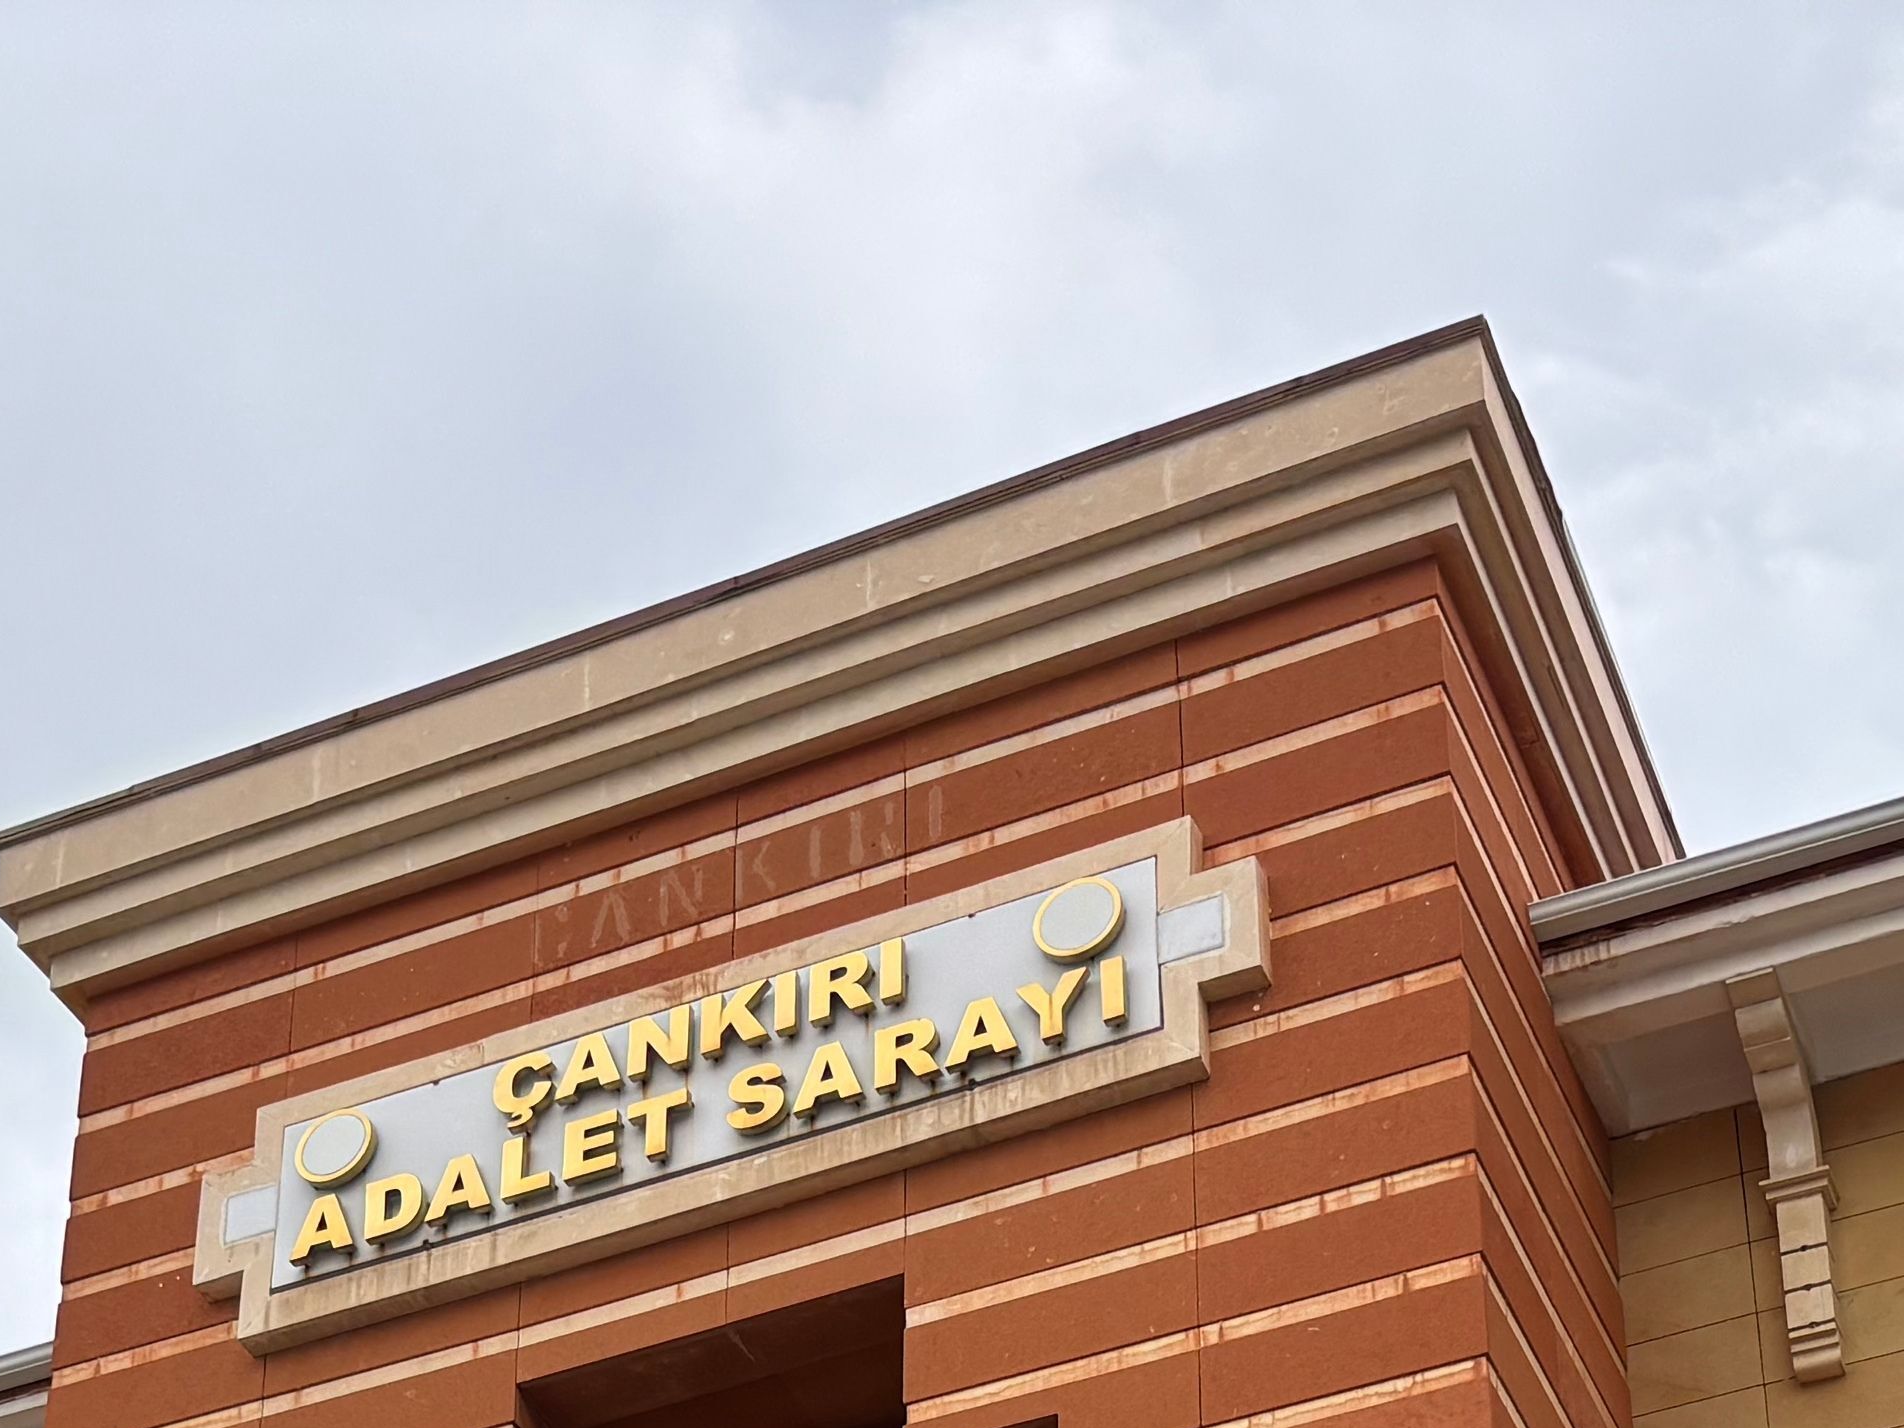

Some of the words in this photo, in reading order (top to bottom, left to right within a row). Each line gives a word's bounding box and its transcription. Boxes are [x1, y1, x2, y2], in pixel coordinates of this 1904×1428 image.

[289, 1087, 692, 1266] ADALET
[725, 955, 1128, 1136] SARAYI
[492, 937, 906, 1129] ÇANKIRI
